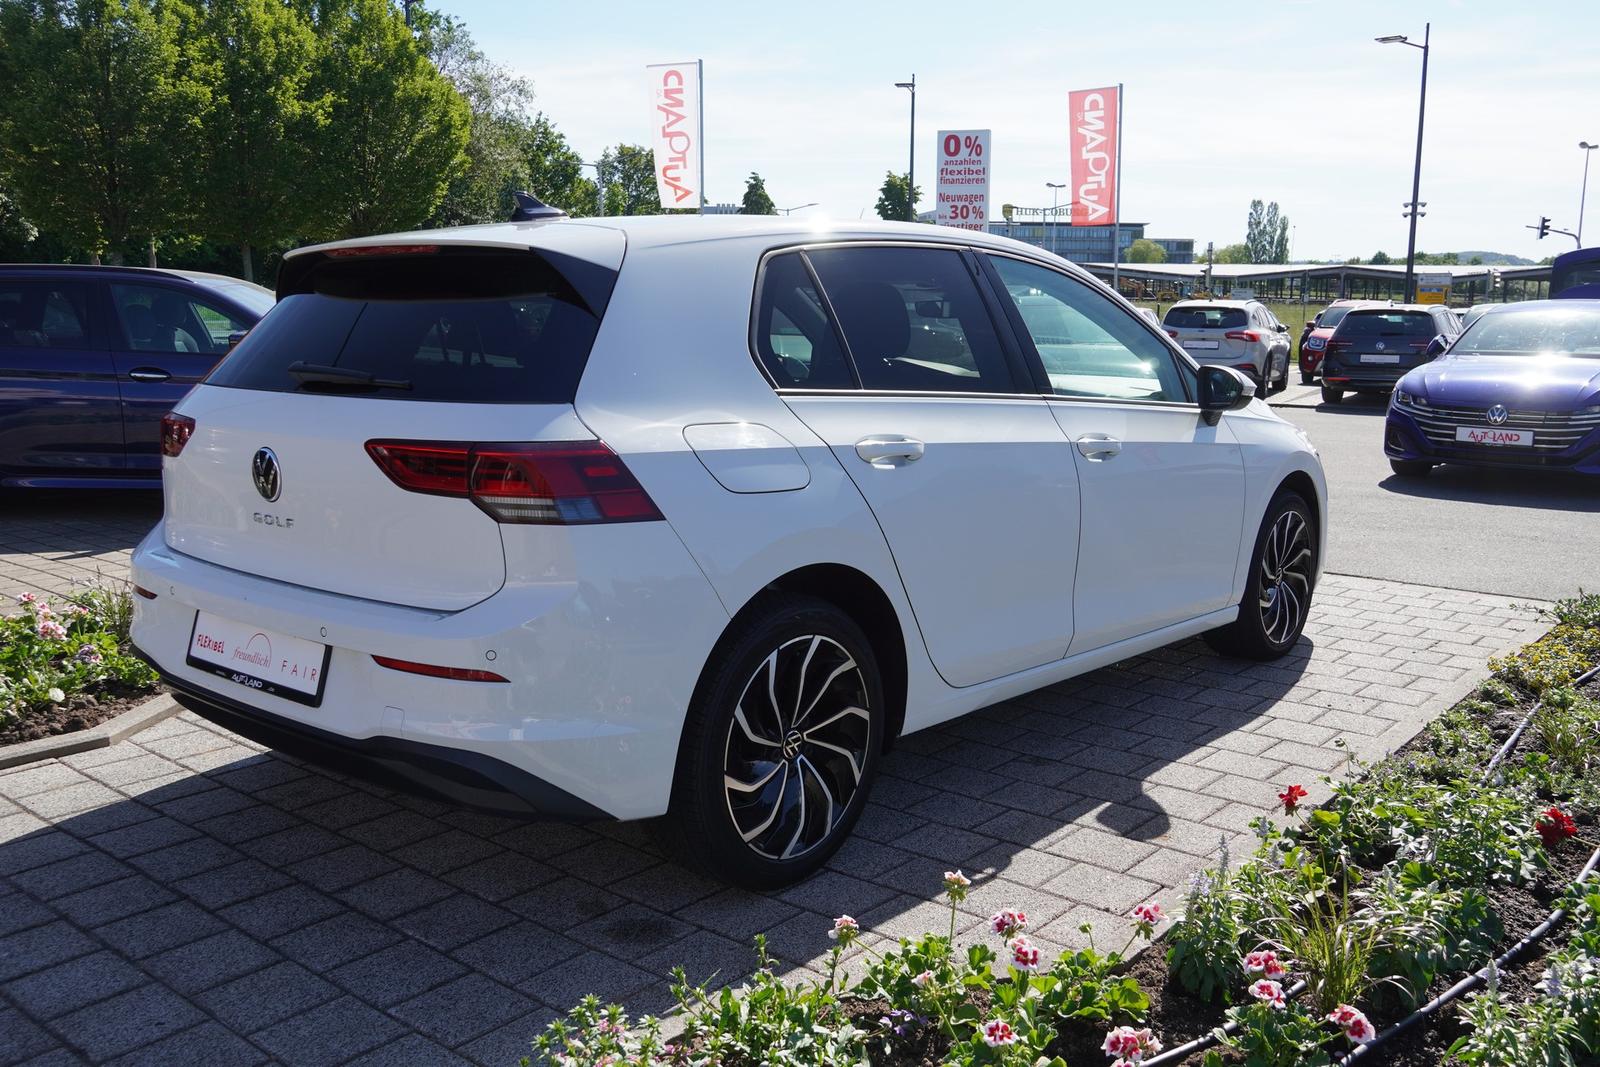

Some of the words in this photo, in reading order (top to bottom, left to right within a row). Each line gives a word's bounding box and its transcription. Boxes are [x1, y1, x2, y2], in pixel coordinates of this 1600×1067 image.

[944, 158, 982, 166] anzahlen
[940, 167, 986, 176] flexibel
[940, 176, 986, 185] finanzieren
[938, 192, 985, 205] Neuwagen
[940, 221, 984, 231] ünstiger
[1468, 430, 1520, 444] AUTOLAND
[253, 512, 294, 528] GOLF
[231, 646, 270, 668] freundlich
